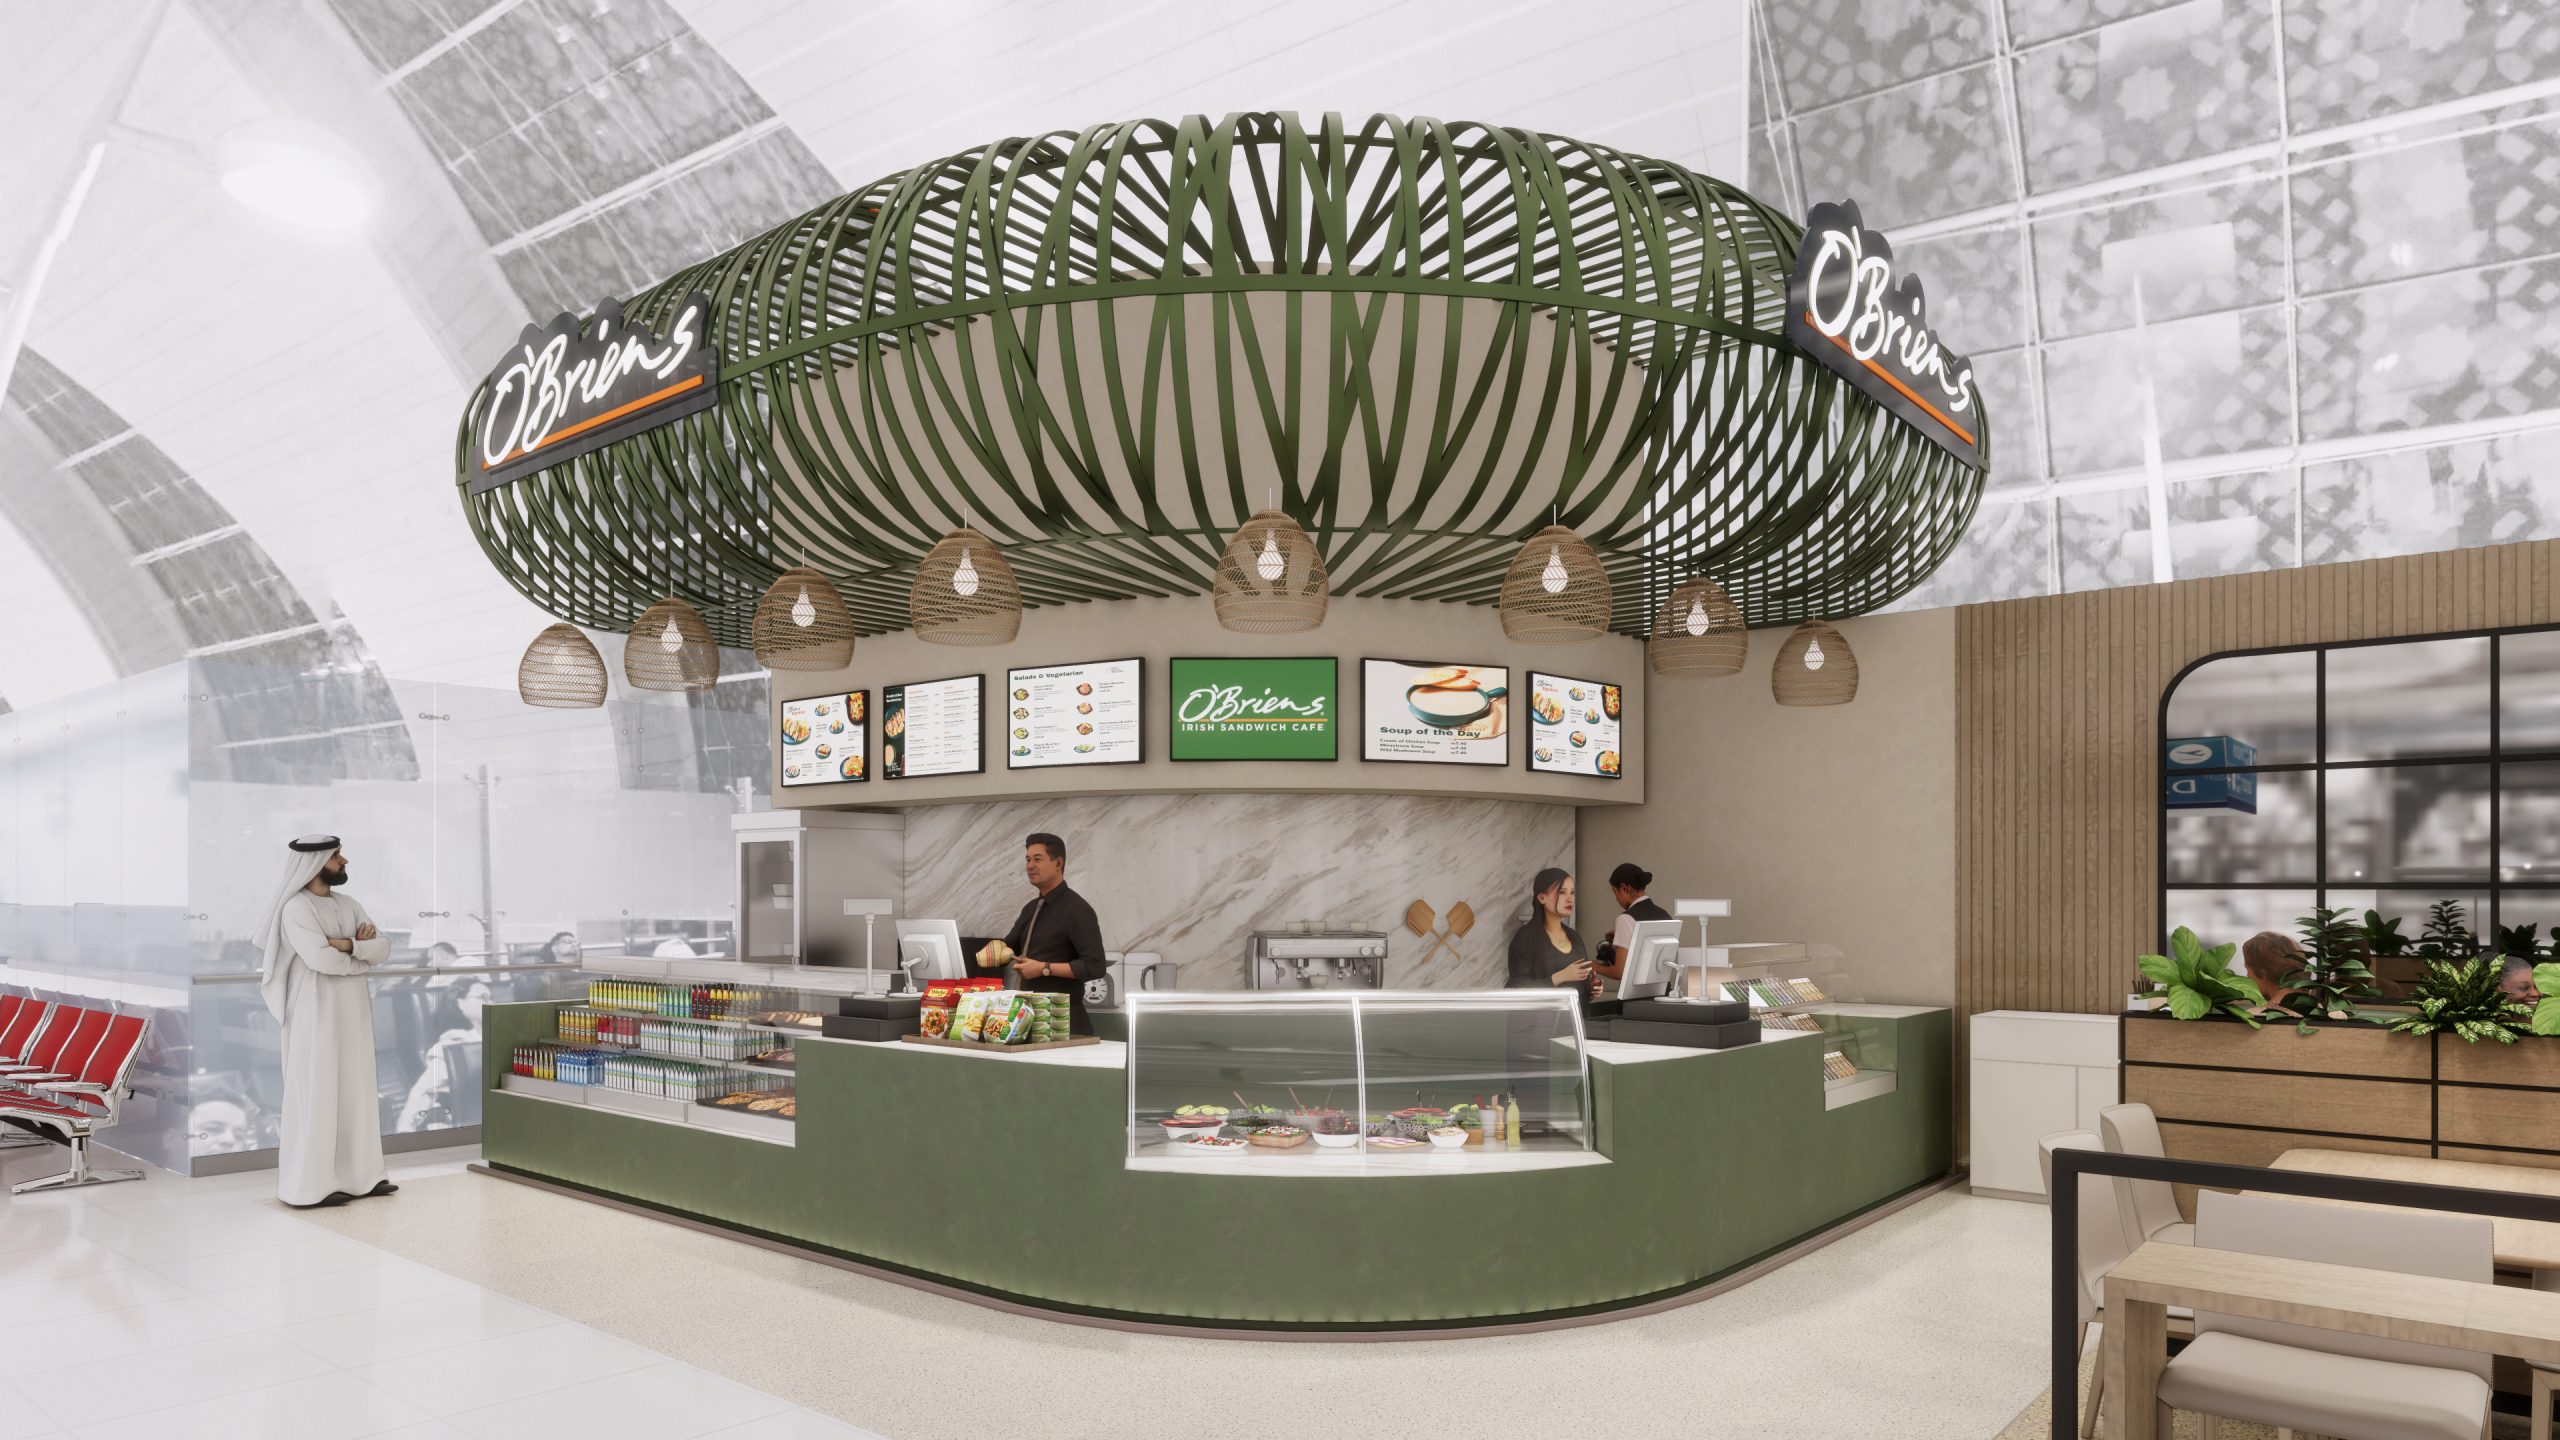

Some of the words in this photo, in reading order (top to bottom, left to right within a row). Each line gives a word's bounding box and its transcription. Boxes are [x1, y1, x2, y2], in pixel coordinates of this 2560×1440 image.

[1808, 225, 1972, 412] O'Briens
[484, 305, 698, 466] O'Briens
[1178, 683, 1326, 723] O'Briens
[1181, 723, 1215, 731] IRISH
[1220, 723, 1287, 732] SANDWICH
[1292, 723, 1324, 731] CAFE
[1380, 726, 1412, 736] Soup
[1433, 728, 1454, 736] the
[1457, 729, 1481, 738] Day
